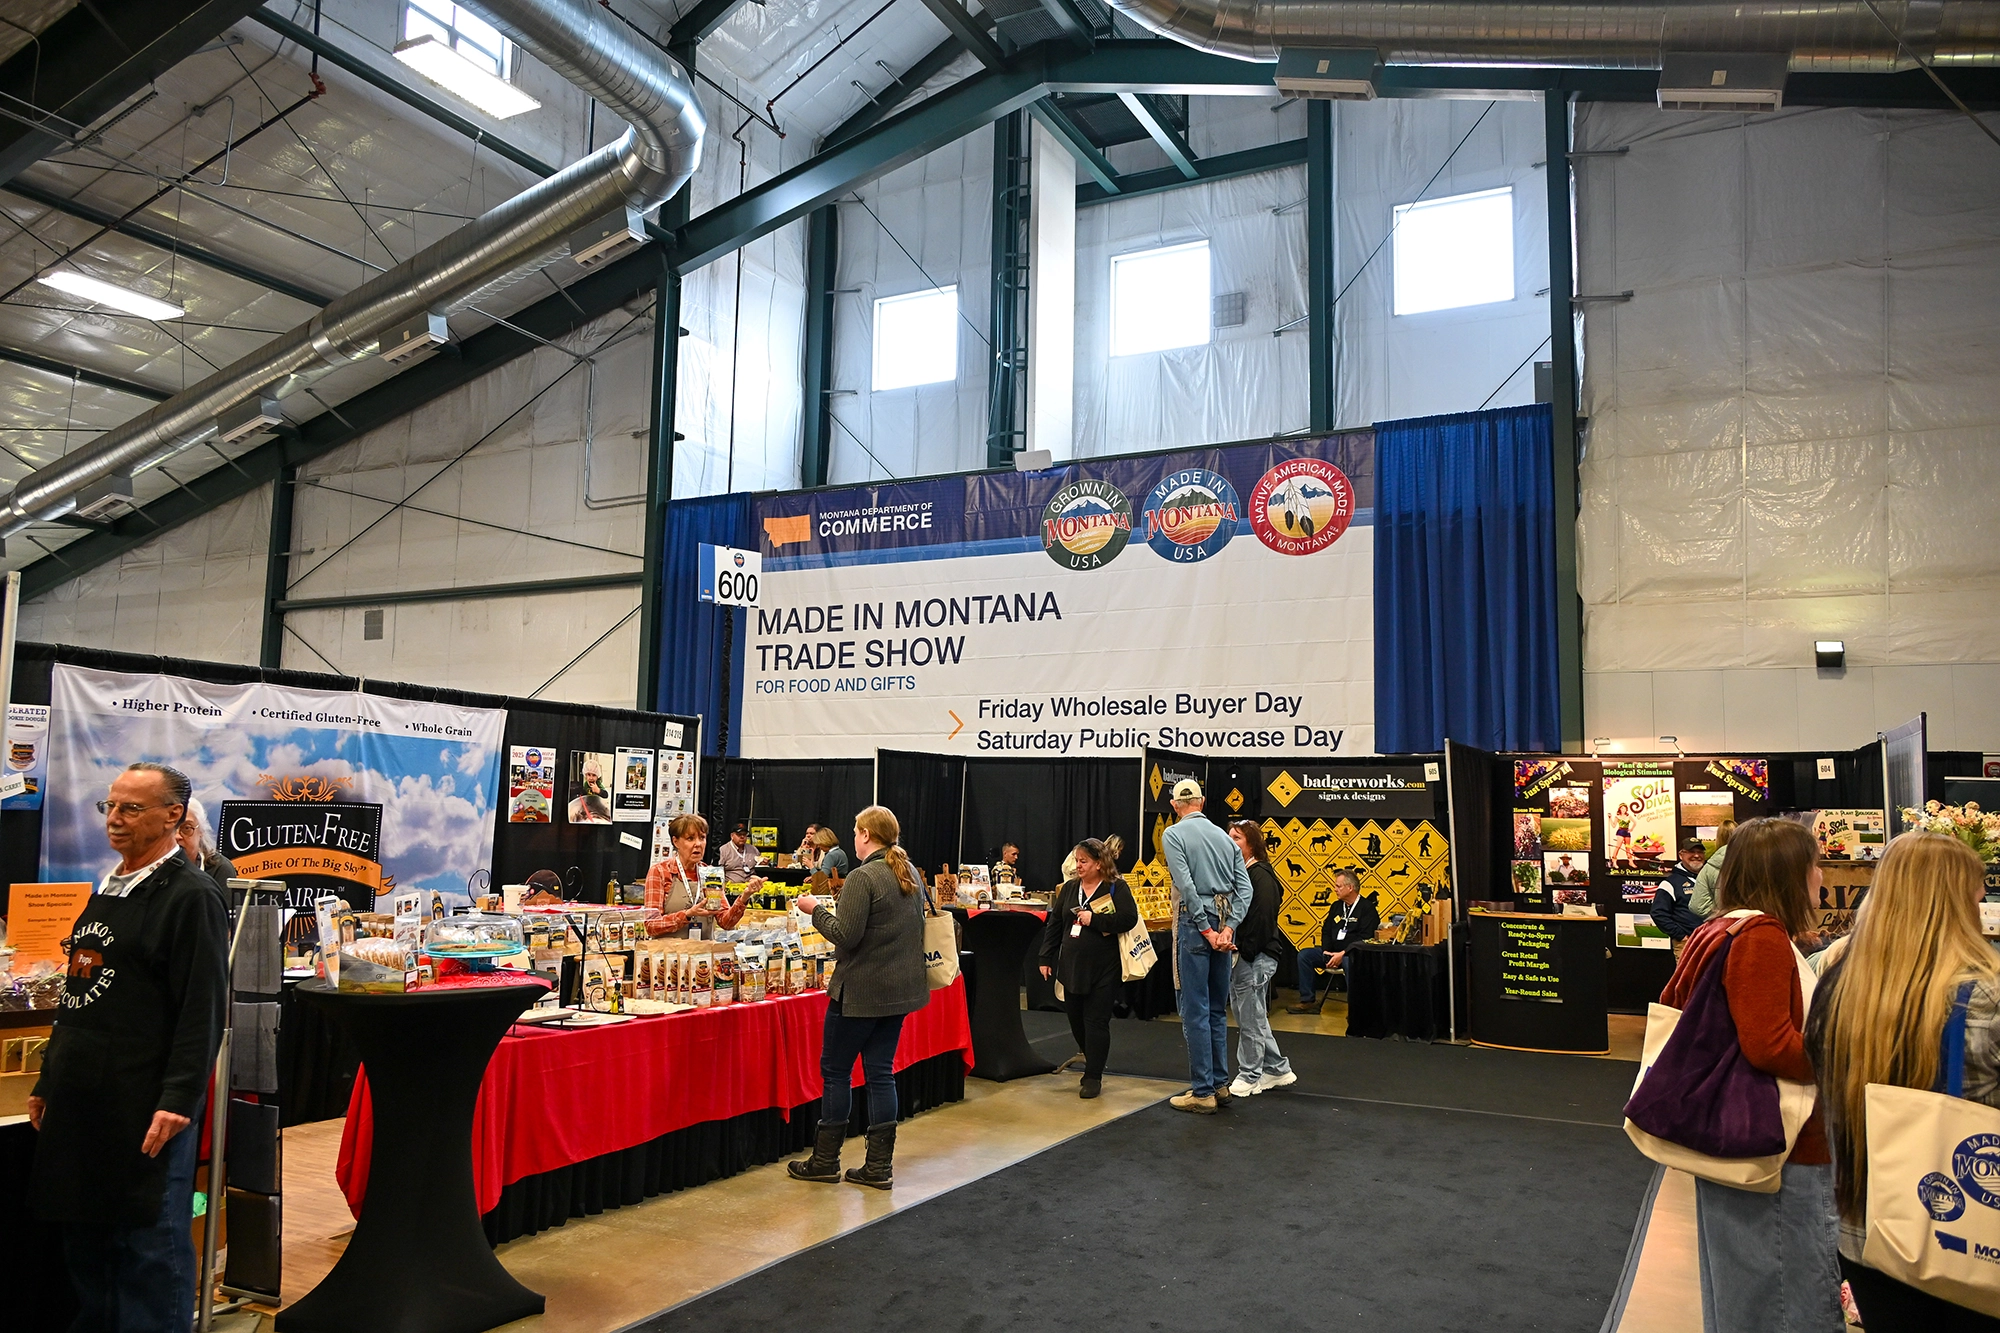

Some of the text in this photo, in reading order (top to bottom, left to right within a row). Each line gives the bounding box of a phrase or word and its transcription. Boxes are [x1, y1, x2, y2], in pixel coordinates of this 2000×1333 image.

[1155, 471, 1226, 500] MADE IN
[1255, 462, 1347, 524] NATIVE AMERICAN MADE
[1050, 483, 1123, 513] GROWN IN
[819, 503, 933, 520] MONTANA DEPARTMENT OF
[819, 512, 933, 538] COMMERCE
[1145, 502, 1237, 540] MONTANA
[1043, 512, 1131, 550] MONTANA
[1262, 528, 1335, 551] IN MONTANA
[1070, 554, 1102, 569] USA
[1173, 545, 1207, 560] USA
[718, 570, 758, 602] 600
[758, 591, 1062, 636] MADE IN MONTANA
[756, 635, 965, 671] TRADE SHOW
[756, 675, 915, 694] FOR FOOD AND GIFTS
[122, 698, 222, 717] Higher Protein
[978, 691, 1302, 722] Friday Wholesale Buyer Day
[260, 707, 381, 728] Certified Gluten-Free
[412, 722, 473, 737] Whole Grain
[977, 725, 1343, 754] Saturday Public Showcase Day
[1603, 769, 1636, 777] Biological
[1820, 765, 1831, 773] 604
[1303, 774, 1425, 791] badgerworks.com
[1523, 784, 1541, 800] Just
[1539, 771, 1562, 789] Spray
[1706, 763, 1763, 802] Just Spray It!
[1318, 791, 1386, 803] signs & designs
[1629, 779, 1670, 814] SOIL
[1646, 794, 1671, 810] DIVA
[230, 812, 371, 853] GLUTEN-FREE
[1829, 818, 1848, 836] SOIL
[262, 858, 283, 871] Bite
[286, 857, 300, 868] Of
[301, 857, 320, 868] The
[322, 858, 341, 873] Big
[1501, 922, 1538, 930] Concentrate
[1508, 931, 1555, 940] Ready-to-Spray
[1518, 940, 1550, 949] Packaging
[78, 954, 93, 966] Pops
[1526, 961, 1550, 970] Margin
[1503, 972, 1517, 981] Easy
[1525, 974, 1539, 982] Safe
[1547, 975, 1560, 983] Use
[1505, 987, 1540, 996] Year-Round
[1949, 1184, 1961, 1196] IN
